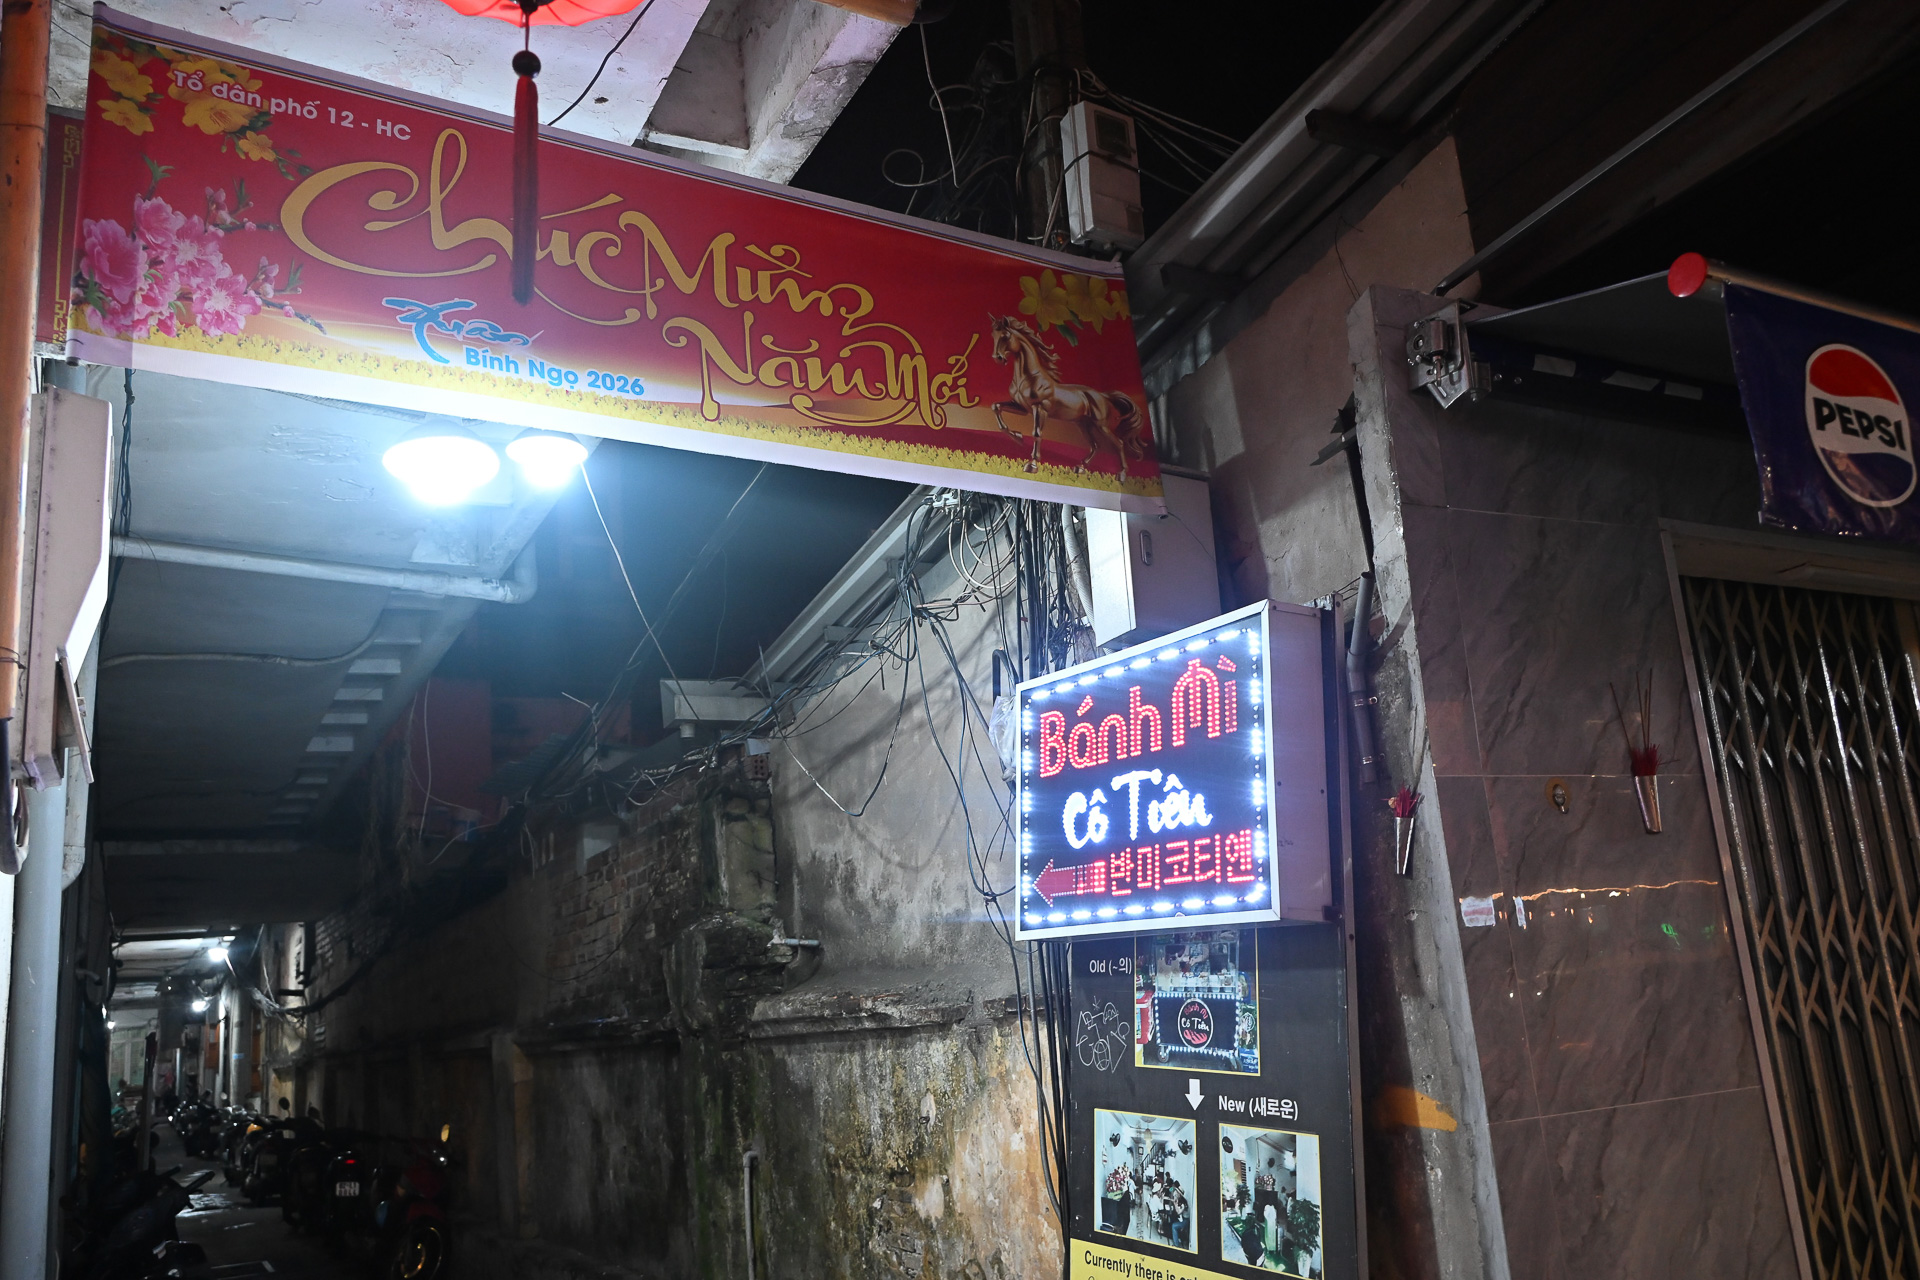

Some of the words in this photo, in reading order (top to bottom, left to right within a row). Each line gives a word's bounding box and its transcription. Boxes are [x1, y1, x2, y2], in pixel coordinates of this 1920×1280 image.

[173, 69, 203, 92] Tổ
[211, 81, 262, 108] dân
[270, 96, 321, 120] phố
[327, 107, 354, 128] 12
[376, 118, 411, 141] HC
[280, 128, 664, 326] Chúc
[619, 210, 880, 337] Mừng
[383, 297, 532, 364] Xuân
[465, 346, 519, 374] Bính
[528, 359, 579, 390] Ngọ
[587, 371, 645, 396] 2026
[663, 311, 886, 422] Năm
[840, 333, 979, 430] Mới
[1812, 397, 1906, 451] PEPSI
[1039, 685, 1162, 778] Bánh
[1171, 655, 1238, 747] Mì
[1062, 788, 1109, 849] Cô
[1111, 768, 1213, 841] Tiên
[1110, 828, 1255, 897] 반미코티엔
[1089, 959, 1106, 973] Old
[1108, 956, 1132, 976] (~의)
[1181, 1017, 1191, 1028] Cô
[1191, 1017, 1210, 1032] Tiên
[1218, 1095, 1245, 1113] New
[1249, 1096, 1298, 1121] (새로운)
[1084, 1250, 1132, 1278] Currently
[1135, 1263, 1163, 1280] there
[1166, 1269, 1176, 1280] is
